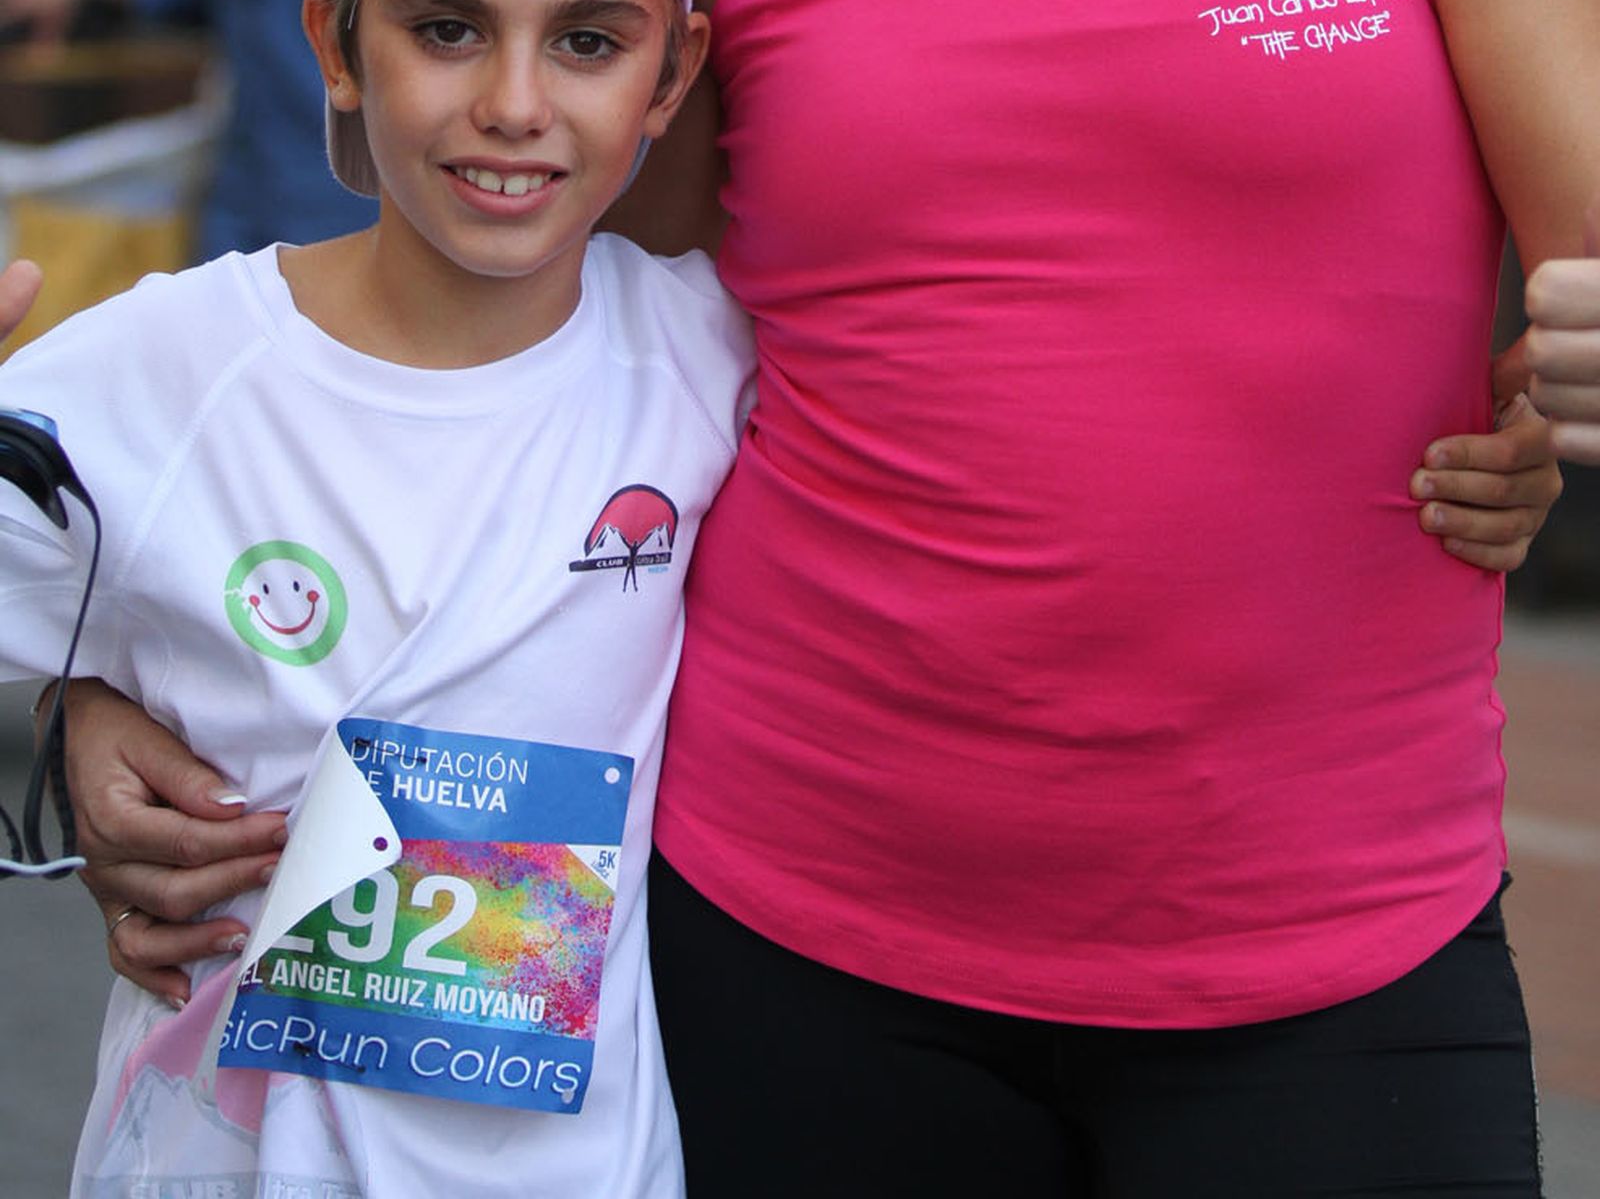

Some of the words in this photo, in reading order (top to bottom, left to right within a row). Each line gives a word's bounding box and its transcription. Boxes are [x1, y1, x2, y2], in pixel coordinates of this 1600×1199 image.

[1198, 3, 1264, 36] Juan
[350, 736, 528, 785] DIPUTACIÓN
[392, 773, 507, 813] HUELVA
[599, 850, 617, 869] 5K
[270, 958, 356, 999] ANGEL
[364, 973, 428, 1007] RUIZ
[433, 984, 546, 1023] MOYANO
[410, 1037, 582, 1094] Colors
